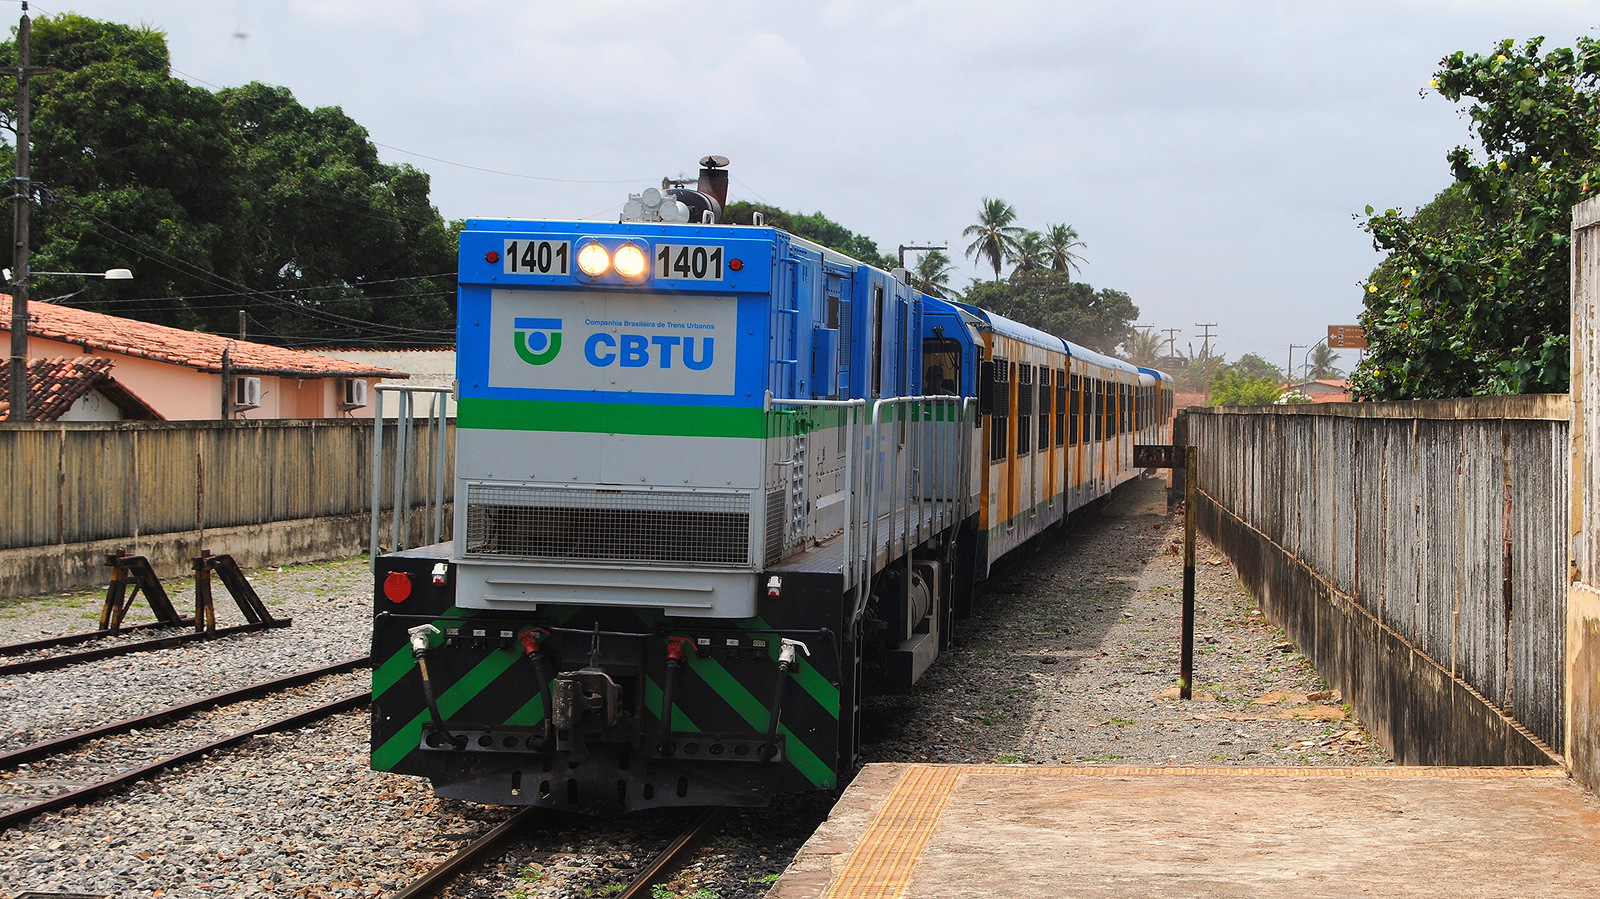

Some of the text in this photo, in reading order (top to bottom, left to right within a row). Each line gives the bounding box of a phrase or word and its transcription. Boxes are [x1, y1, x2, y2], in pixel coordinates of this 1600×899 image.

[506, 240, 568, 274] 1401
[657, 245, 722, 279] 1401
[584, 319, 622, 327] Companhia
[623, 320, 655, 328] Brasileira
[584, 332, 715, 371] CBTU
